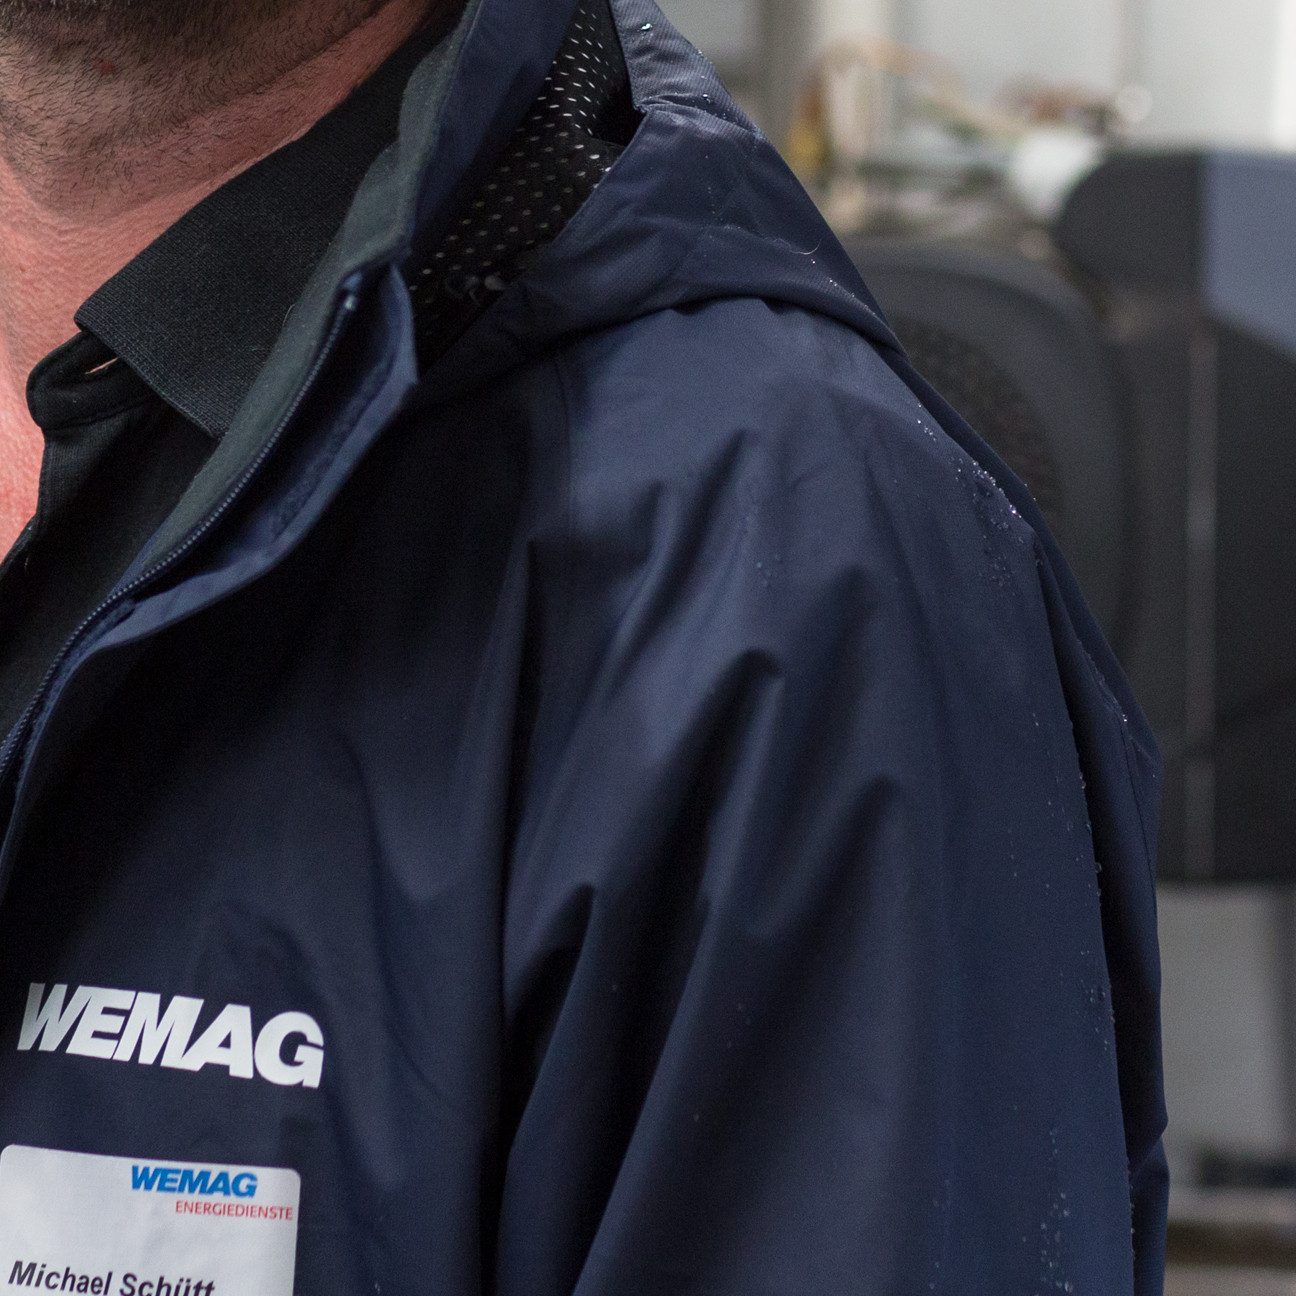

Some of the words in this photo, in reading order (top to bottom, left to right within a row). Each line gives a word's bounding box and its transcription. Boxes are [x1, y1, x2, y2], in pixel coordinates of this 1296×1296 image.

[16, 982, 324, 1089] WEMAG
[131, 1164, 258, 1198] WEMAG
[175, 1200, 293, 1221] ENERGIEDIENSTE
[8, 1260, 113, 1296] Michael
